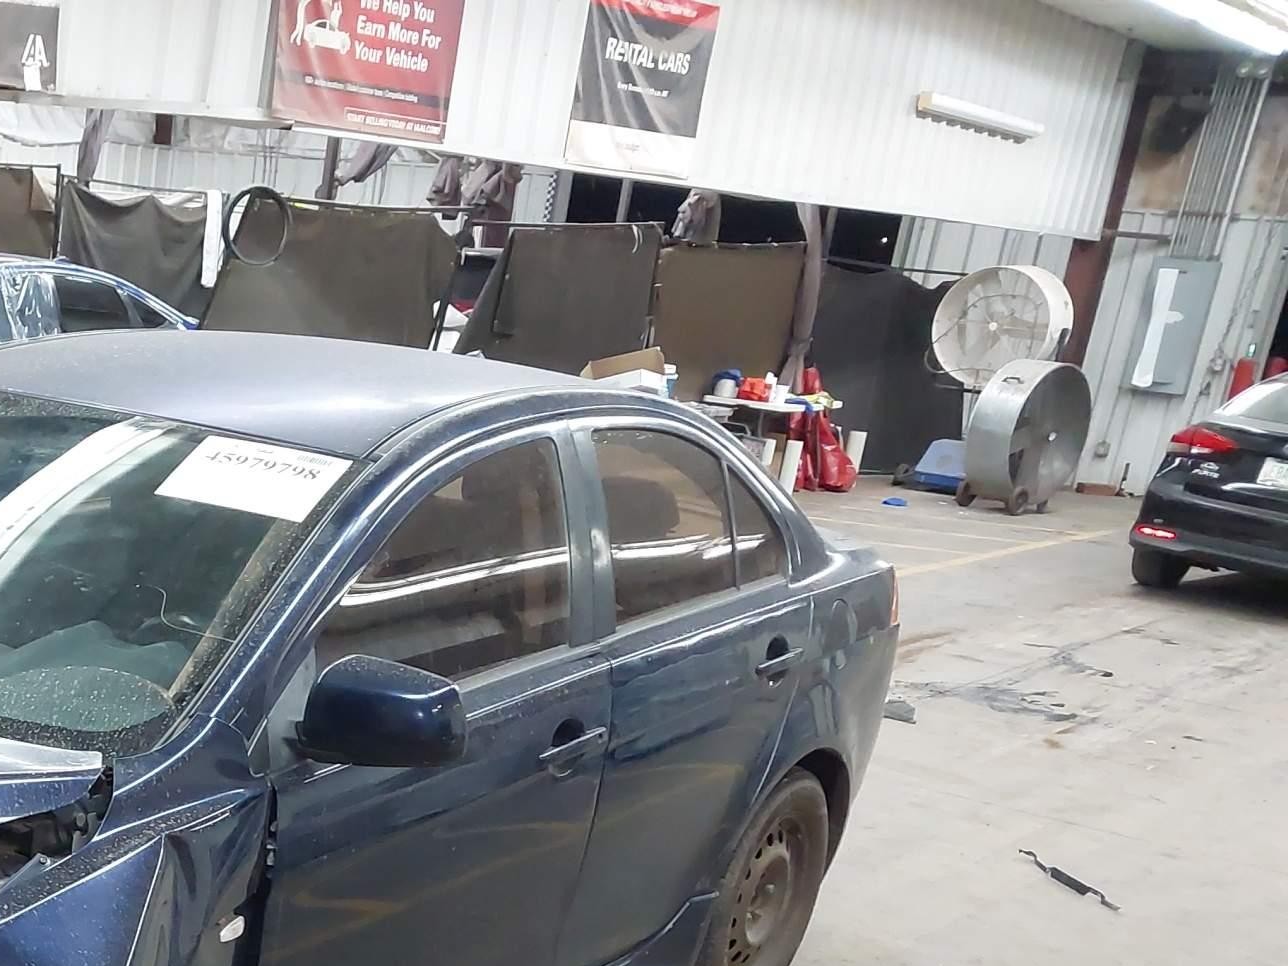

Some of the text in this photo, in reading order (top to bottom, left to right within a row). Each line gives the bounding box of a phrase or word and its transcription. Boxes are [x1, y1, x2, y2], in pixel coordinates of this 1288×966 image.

[382, 0, 411, 22] Help
[413, 1, 435, 23] You
[356, 15, 442, 50] Earn More For
[354, 40, 429, 73] Your Vehicle
[604, 37, 691, 75] RENTAL CARS
[204, 450, 321, 480] 45979798
